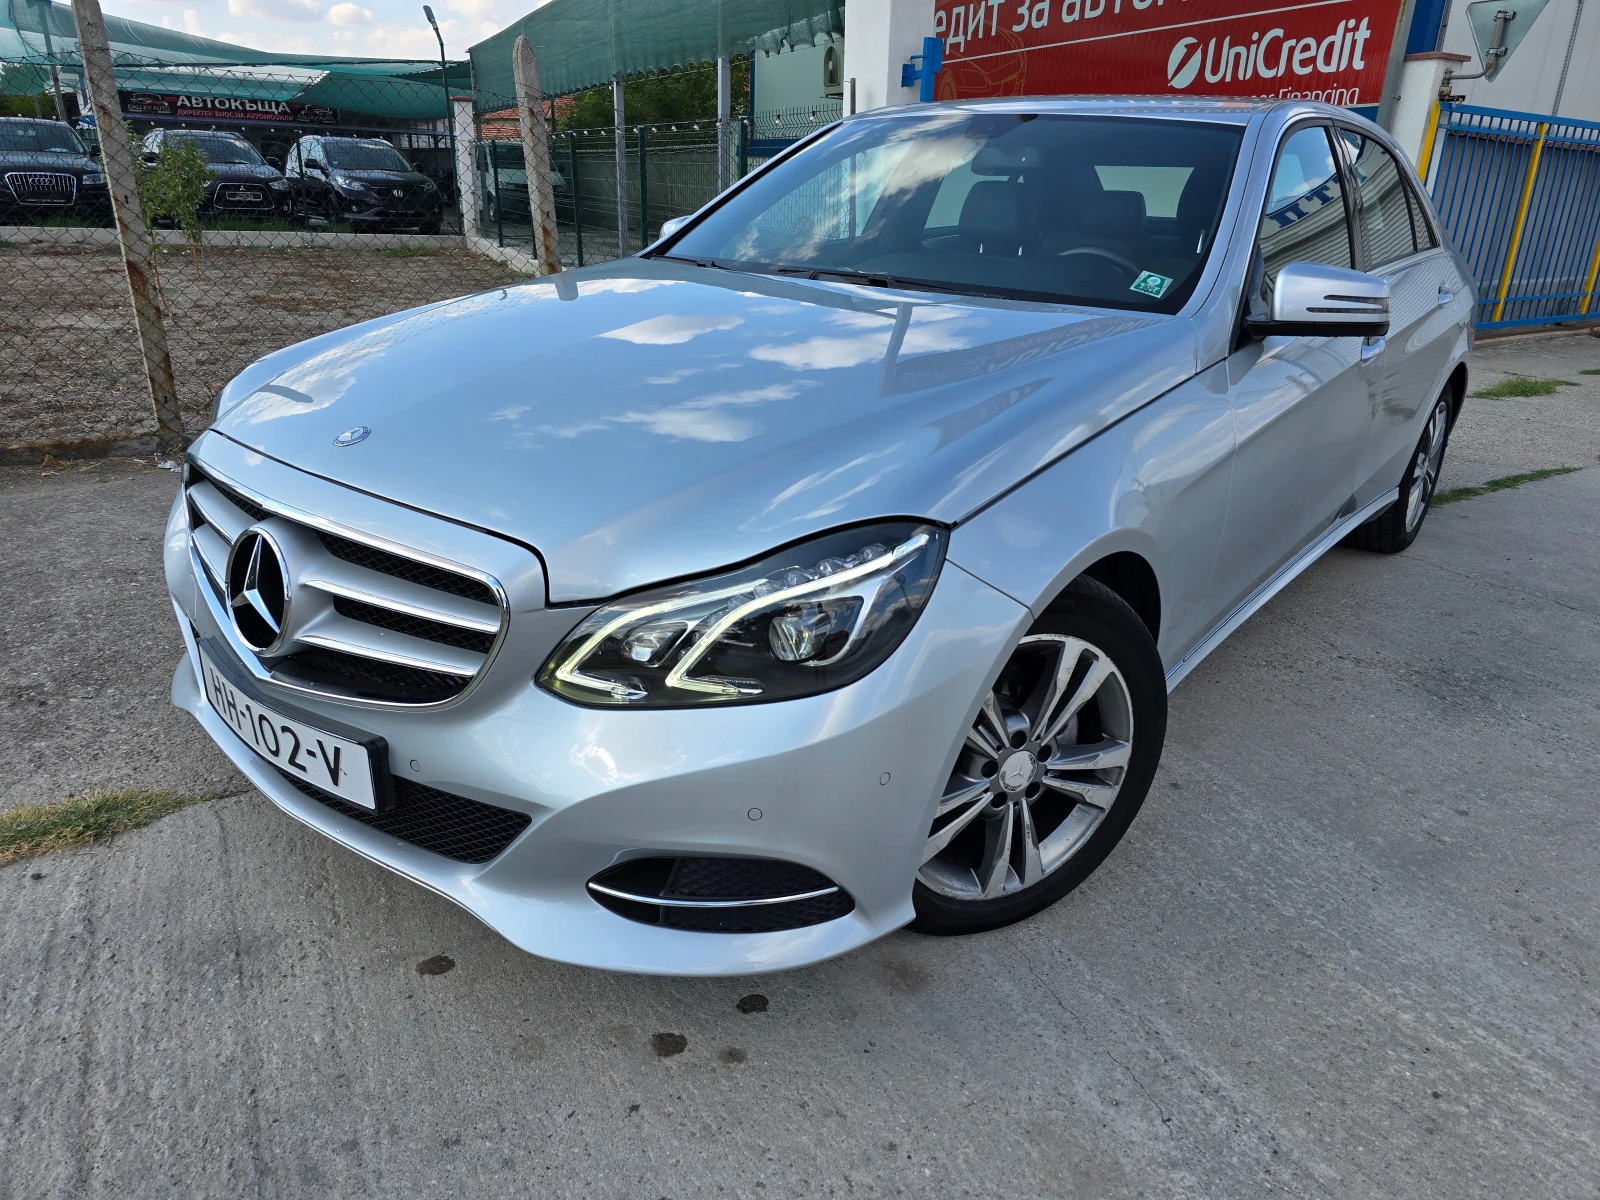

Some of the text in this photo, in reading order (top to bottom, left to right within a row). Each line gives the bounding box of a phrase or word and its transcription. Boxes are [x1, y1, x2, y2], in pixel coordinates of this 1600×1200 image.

[1011, 0, 1051, 32] за
[1204, 16, 1371, 84] UniCredit
[176, 95, 291, 114] АВТОКЪЩА
[177, 108, 214, 117] ДИРЕКТЕН
[215, 110, 235, 118] ВНОС
[246, 113, 294, 121] АВТОМОБИЛИ
